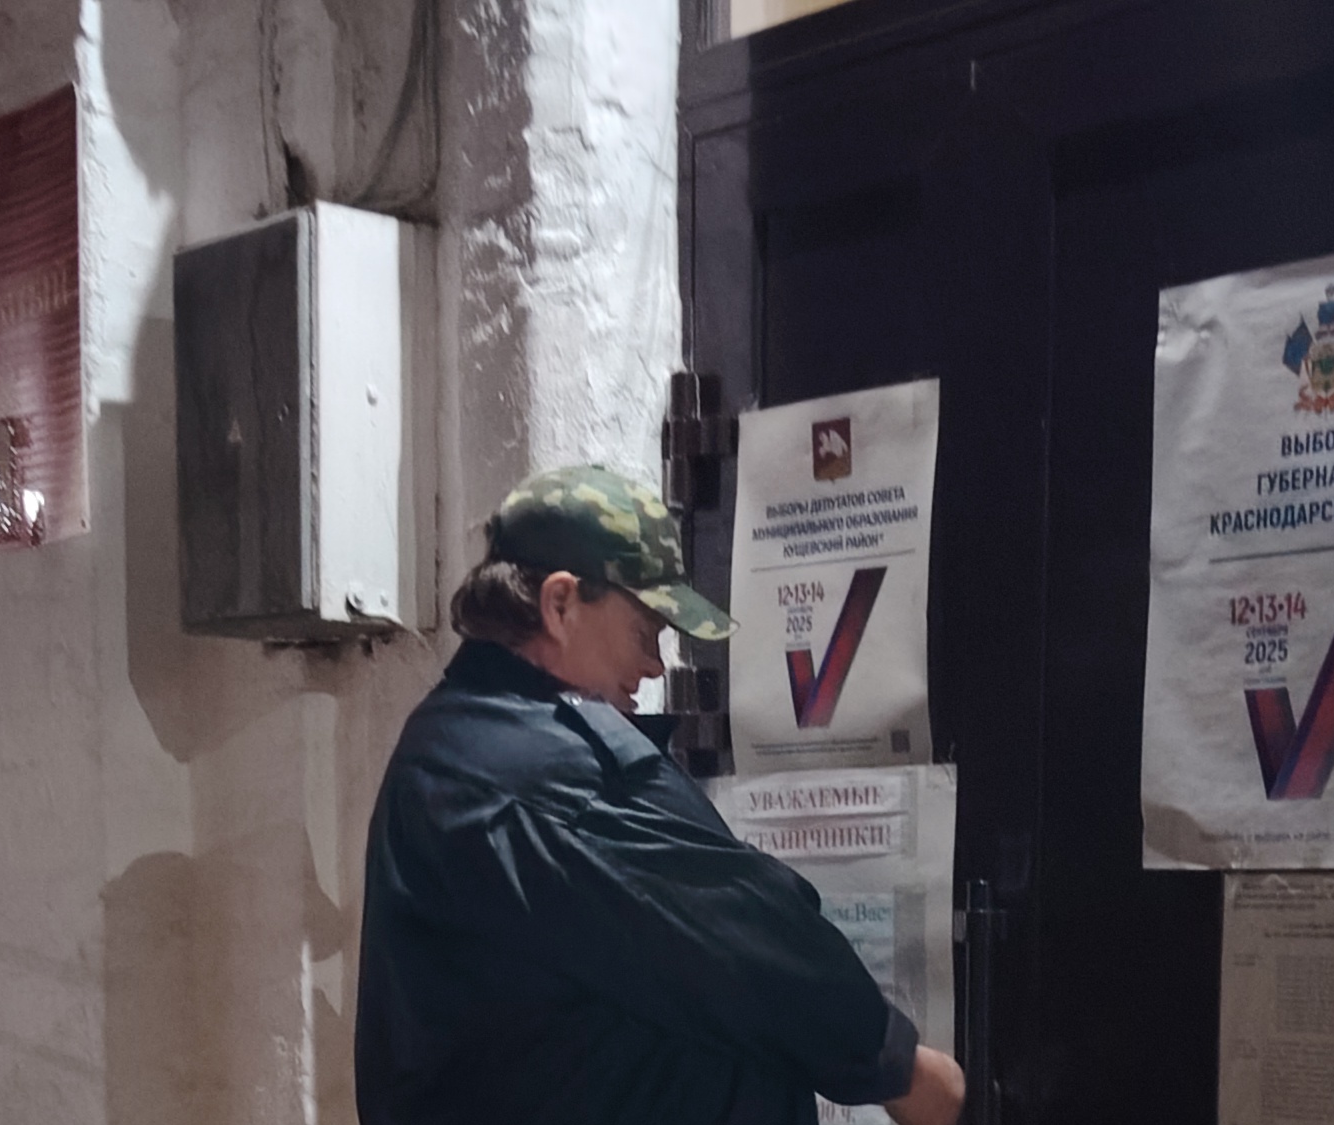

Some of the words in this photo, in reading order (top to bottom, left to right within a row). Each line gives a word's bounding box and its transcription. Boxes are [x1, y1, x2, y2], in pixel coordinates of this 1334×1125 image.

[785, 615, 813, 634] 2025
[1244, 638, 1288, 665] 2025
[748, 783, 884, 812] УВАЖАЕМЫЕ
